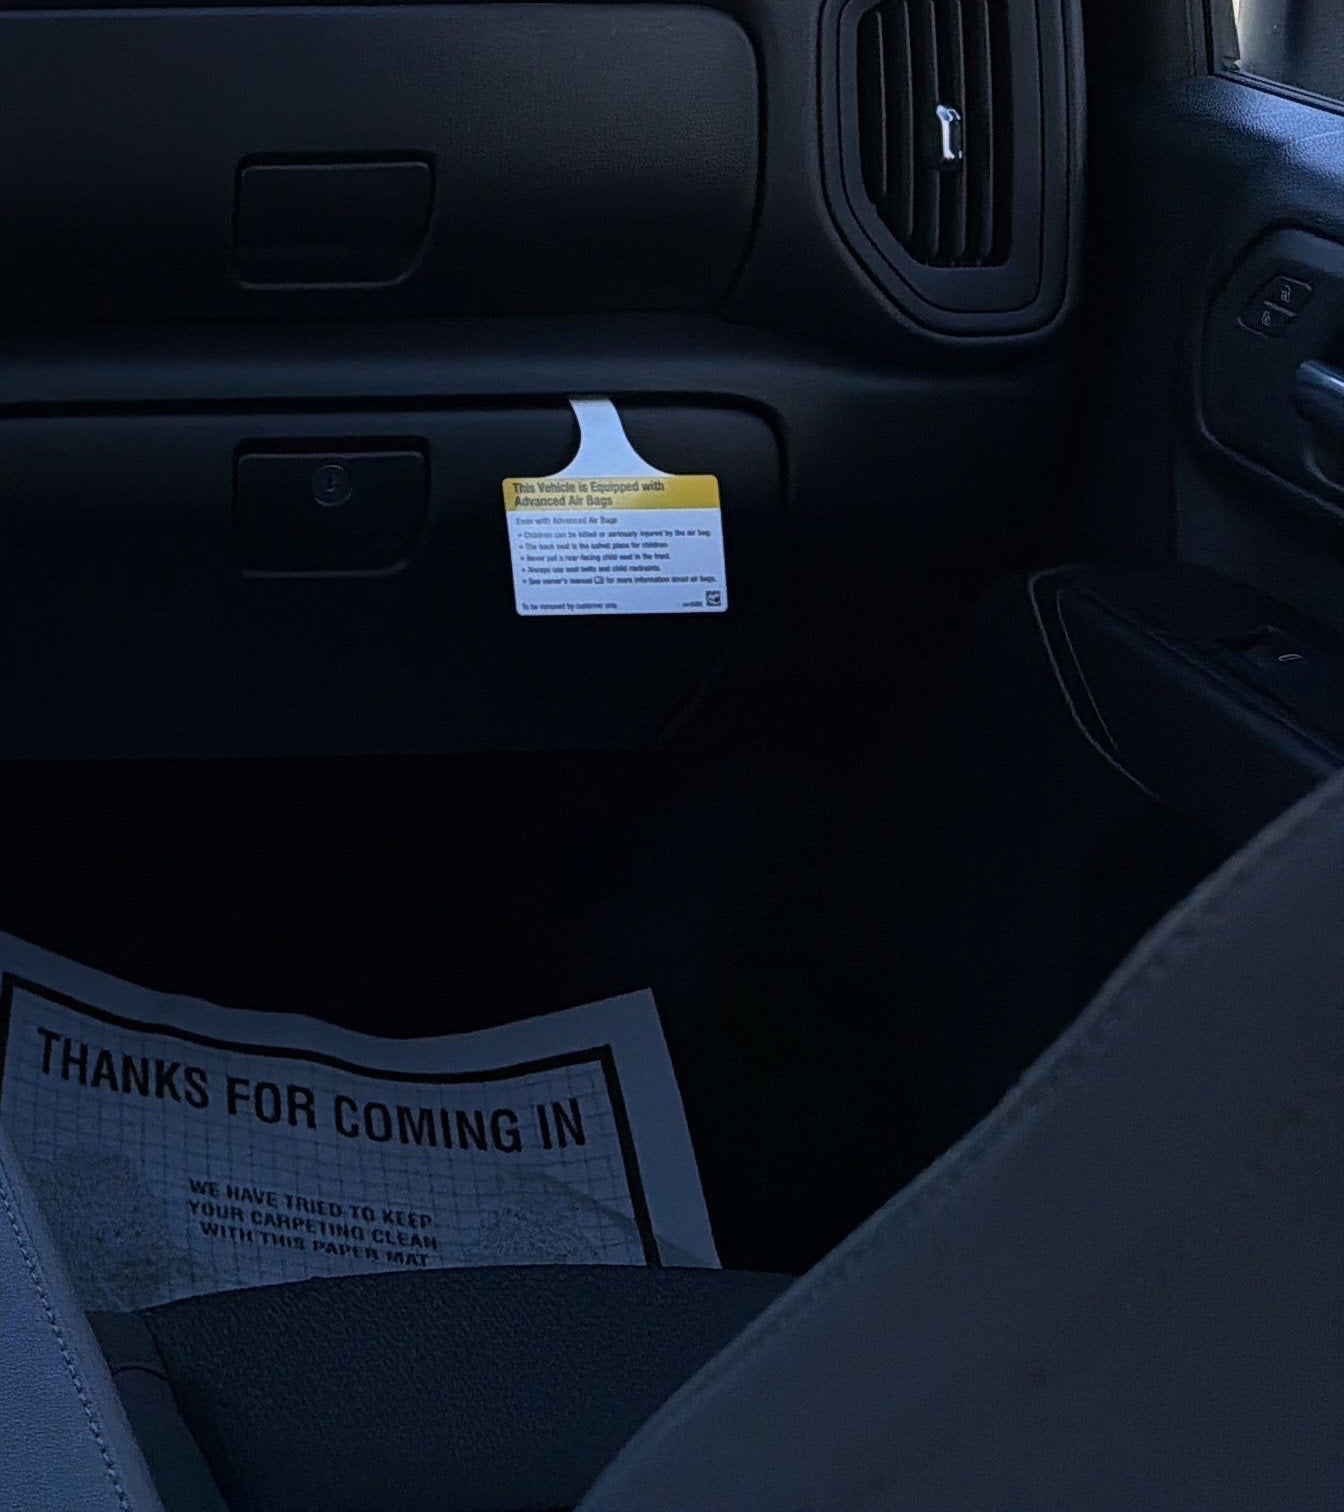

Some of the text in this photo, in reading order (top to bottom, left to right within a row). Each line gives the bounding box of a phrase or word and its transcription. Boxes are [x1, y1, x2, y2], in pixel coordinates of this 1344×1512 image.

[512, 480, 665, 494] This Vehicle is Equipped with
[515, 494, 613, 508] Advanced Air Bags
[35, 1026, 587, 1154] THANKS FOR COMING IN
[186, 1198, 440, 1251] YOUR CARPETING CLEAN
[189, 1178, 433, 1230] WE HAVE TRIED TO KEEP
[200, 1220, 429, 1267] WITH THIS PAPER MAT
